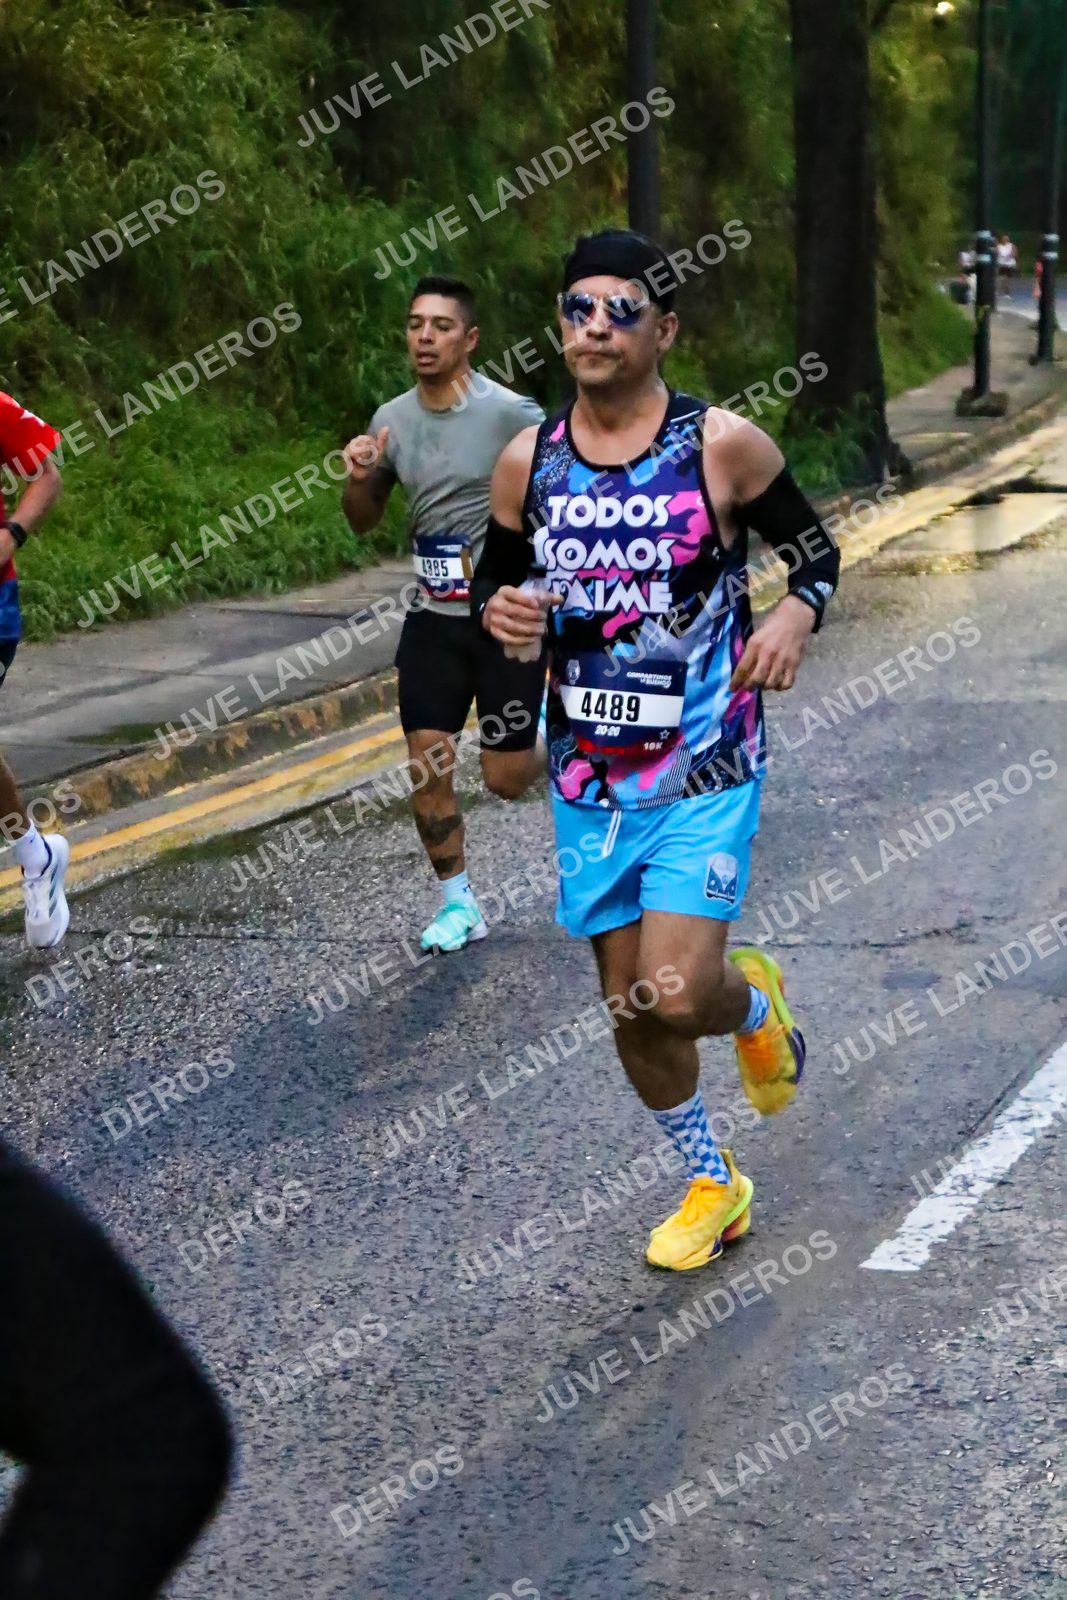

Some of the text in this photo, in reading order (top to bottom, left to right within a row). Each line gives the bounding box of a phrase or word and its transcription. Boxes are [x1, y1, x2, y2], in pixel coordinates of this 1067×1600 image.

[548, 494, 673, 528] TODOS
[422, 558, 448, 577] 4385
[544, 537, 675, 571] SOMOS
[581, 690, 640, 722] 4489
